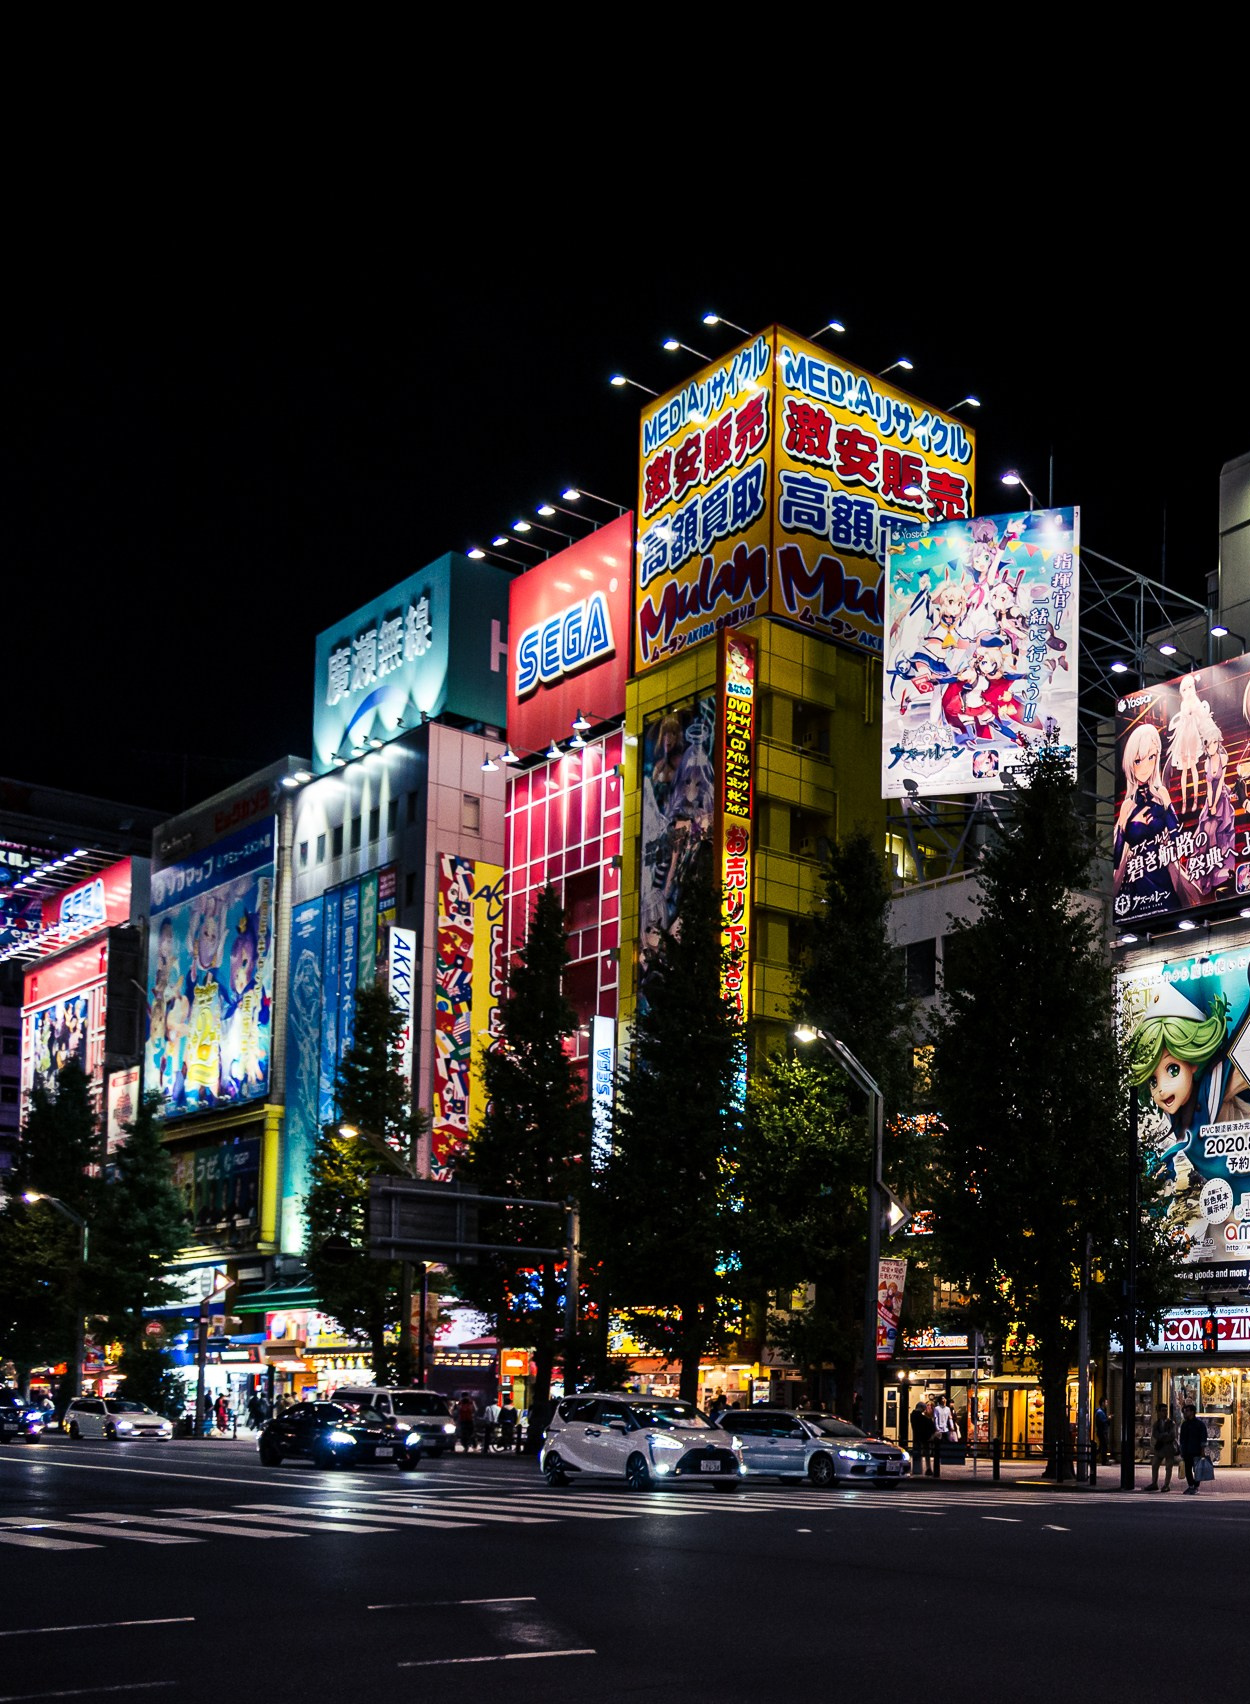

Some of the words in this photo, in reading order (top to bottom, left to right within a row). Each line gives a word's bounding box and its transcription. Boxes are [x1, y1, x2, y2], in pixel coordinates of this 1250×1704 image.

[643, 393, 769, 517] 激安販売
[784, 398, 969, 522] 激安販売
[640, 457, 765, 588] 高額買取
[639, 543, 768, 663] Mulan
[516, 591, 617, 697] SEGA
[727, 698, 751, 715] DVD
[1126, 693, 1153, 709] Yostar
[726, 723, 750, 741] ゲーム
[730, 738, 747, 752] CD
[726, 748, 750, 765] アイドル
[726, 762, 750, 778] アニメ
[726, 776, 749, 792] コミック
[727, 790, 749, 803] ホビー
[726, 801, 749, 817] フィギュア
[1126, 832, 1207, 884] 碧き航路の
[1194, 1269, 1214, 1281] goods
[1216, 1269, 1228, 1278] and
[1229, 1268, 1247, 1278] more
[1166, 1318, 1227, 1341] COMC
